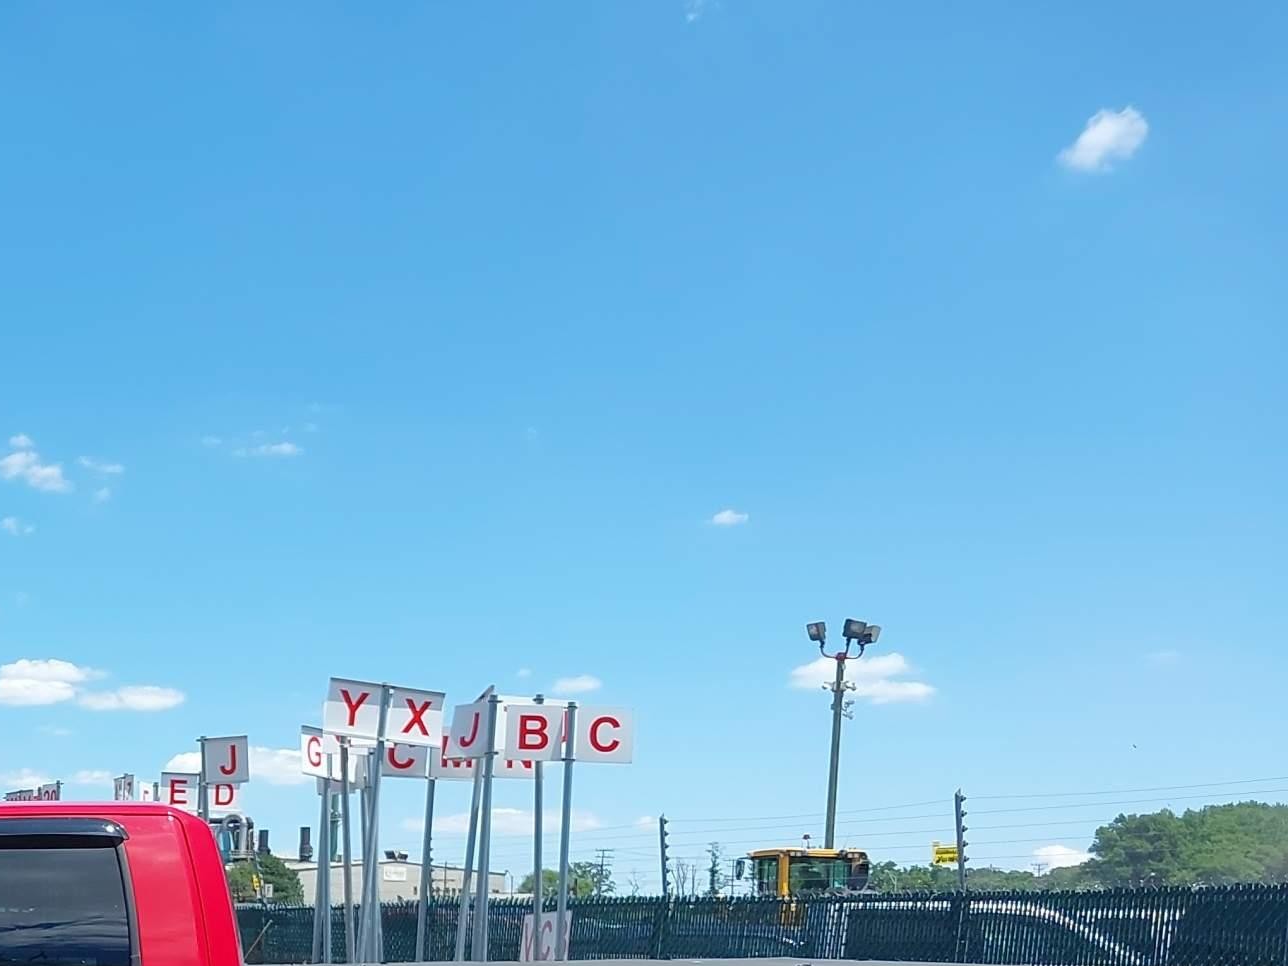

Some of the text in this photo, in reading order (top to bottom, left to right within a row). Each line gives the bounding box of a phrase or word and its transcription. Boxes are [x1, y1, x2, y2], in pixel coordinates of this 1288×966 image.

[340, 688, 370, 727] Y
[401, 698, 433, 737] X
[459, 712, 480, 748] J
[518, 714, 550, 751] B
[589, 716, 621, 753] C
[219, 744, 237, 775] J
[307, 736, 322, 768] G
[169, 779, 188, 805] E
[214, 783, 234, 806] D
